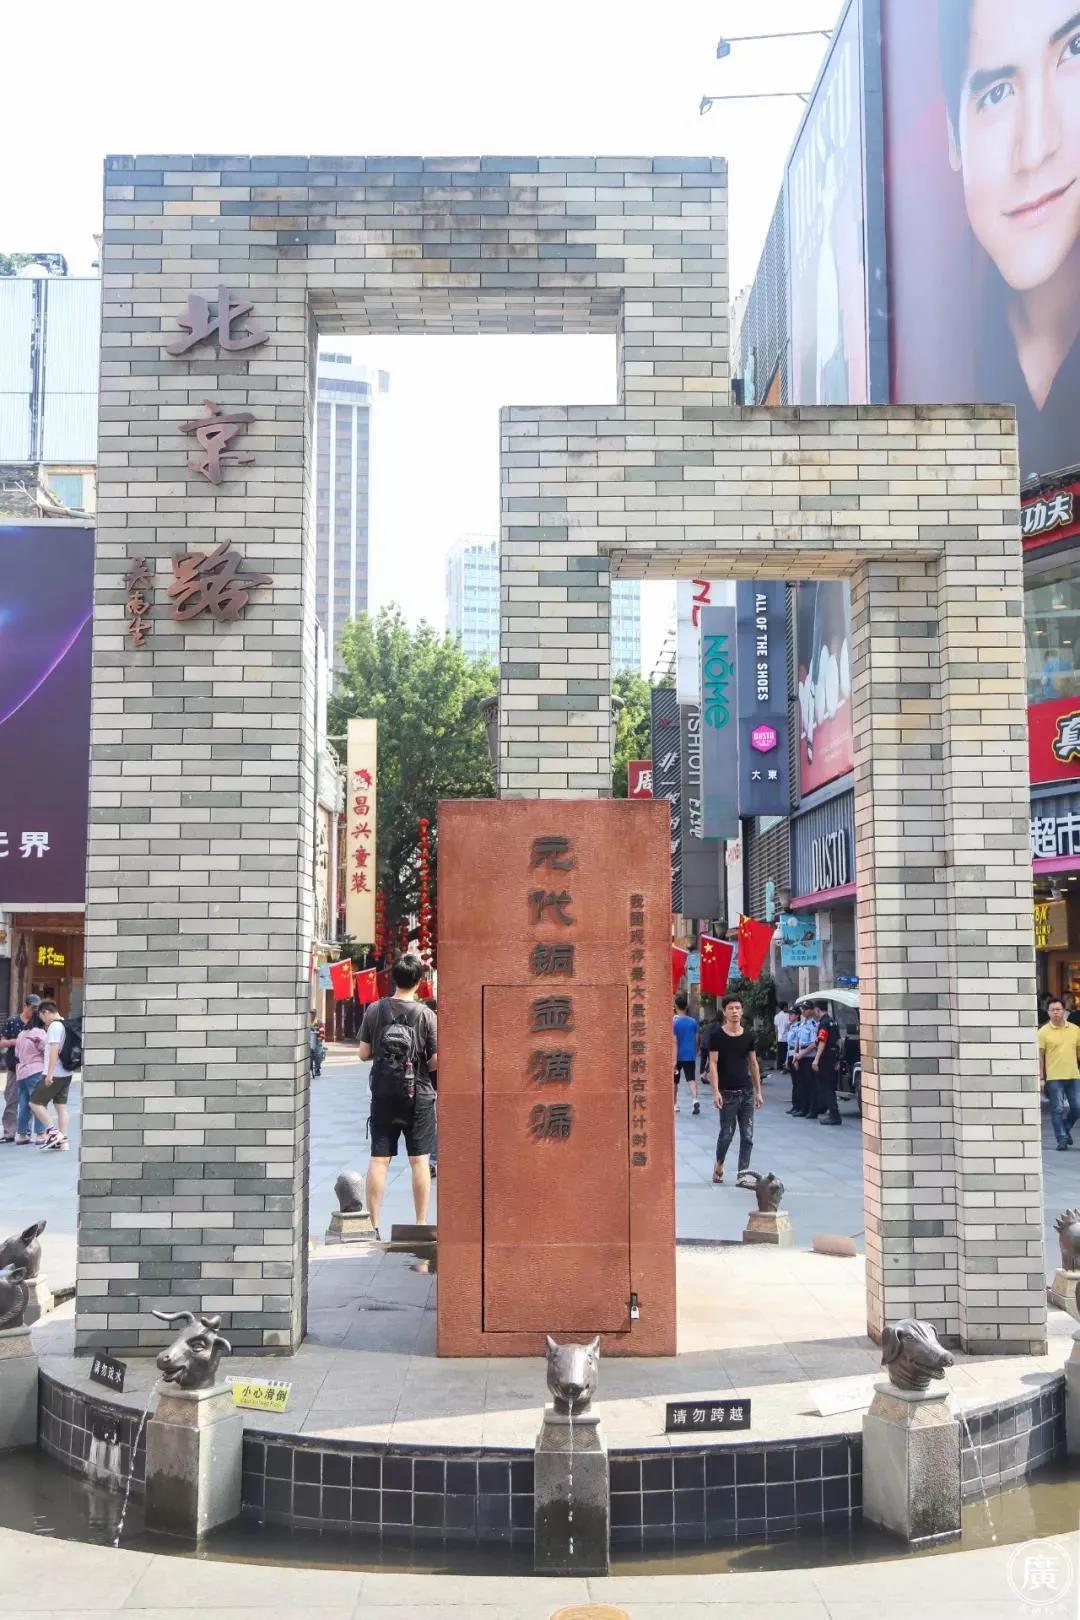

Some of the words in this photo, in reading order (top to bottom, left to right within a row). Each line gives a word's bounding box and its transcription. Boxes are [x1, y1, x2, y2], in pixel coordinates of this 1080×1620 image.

[166, 284, 273, 622] 北京路
[1020, 495, 1070, 533] 功夫
[755, 593, 767, 613] ALL
[756, 617, 768, 631] OF
[756, 634, 768, 657] THE
[757, 663, 769, 701] SHOES
[752, 770, 777, 780] 大東
[351, 796, 372, 893] 昌兴童装
[1031, 812, 1079, 857] 超市
[812, 828, 847, 892] DUSTO
[242, 1386, 288, 1402] 小心滑倒
[672, 1406, 744, 1424] 请勿跨越
